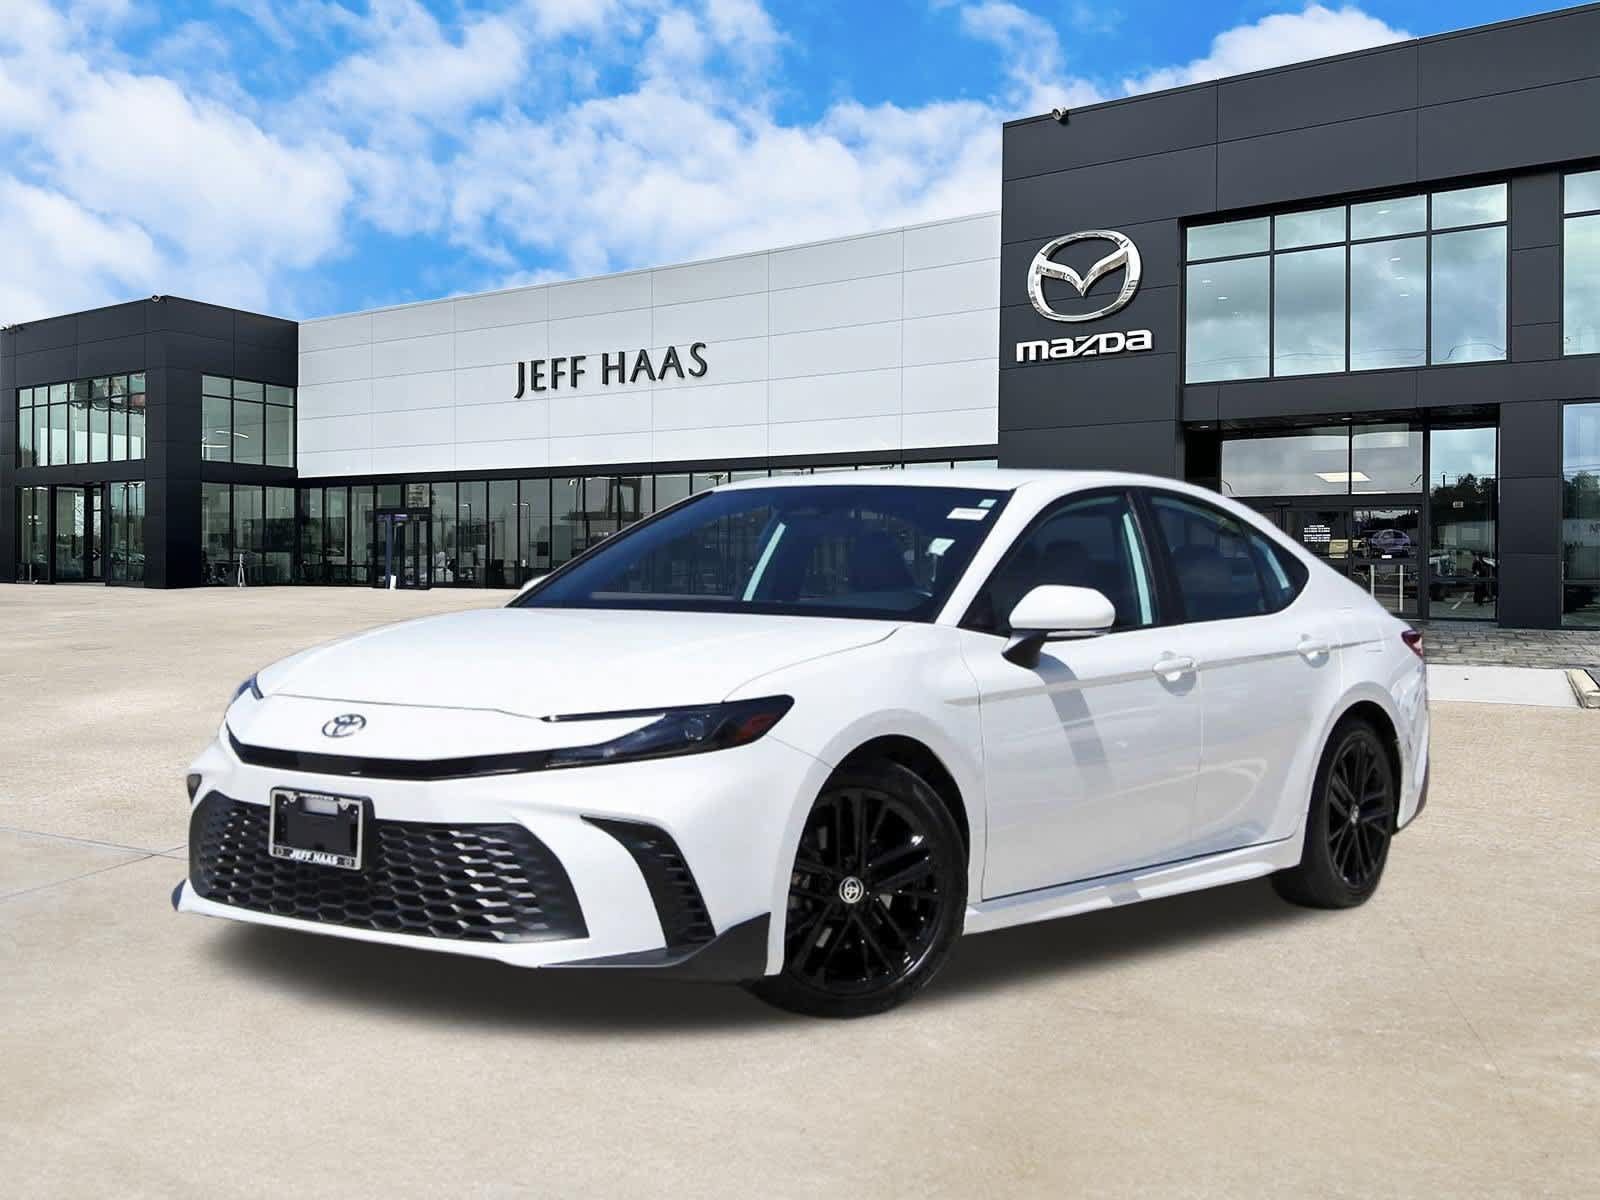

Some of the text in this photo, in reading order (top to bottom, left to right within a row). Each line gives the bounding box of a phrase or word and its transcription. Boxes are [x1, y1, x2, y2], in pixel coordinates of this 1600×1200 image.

[514, 342, 708, 399] JEFF HAAS
[290, 848, 338, 865] JEFF HAAS
